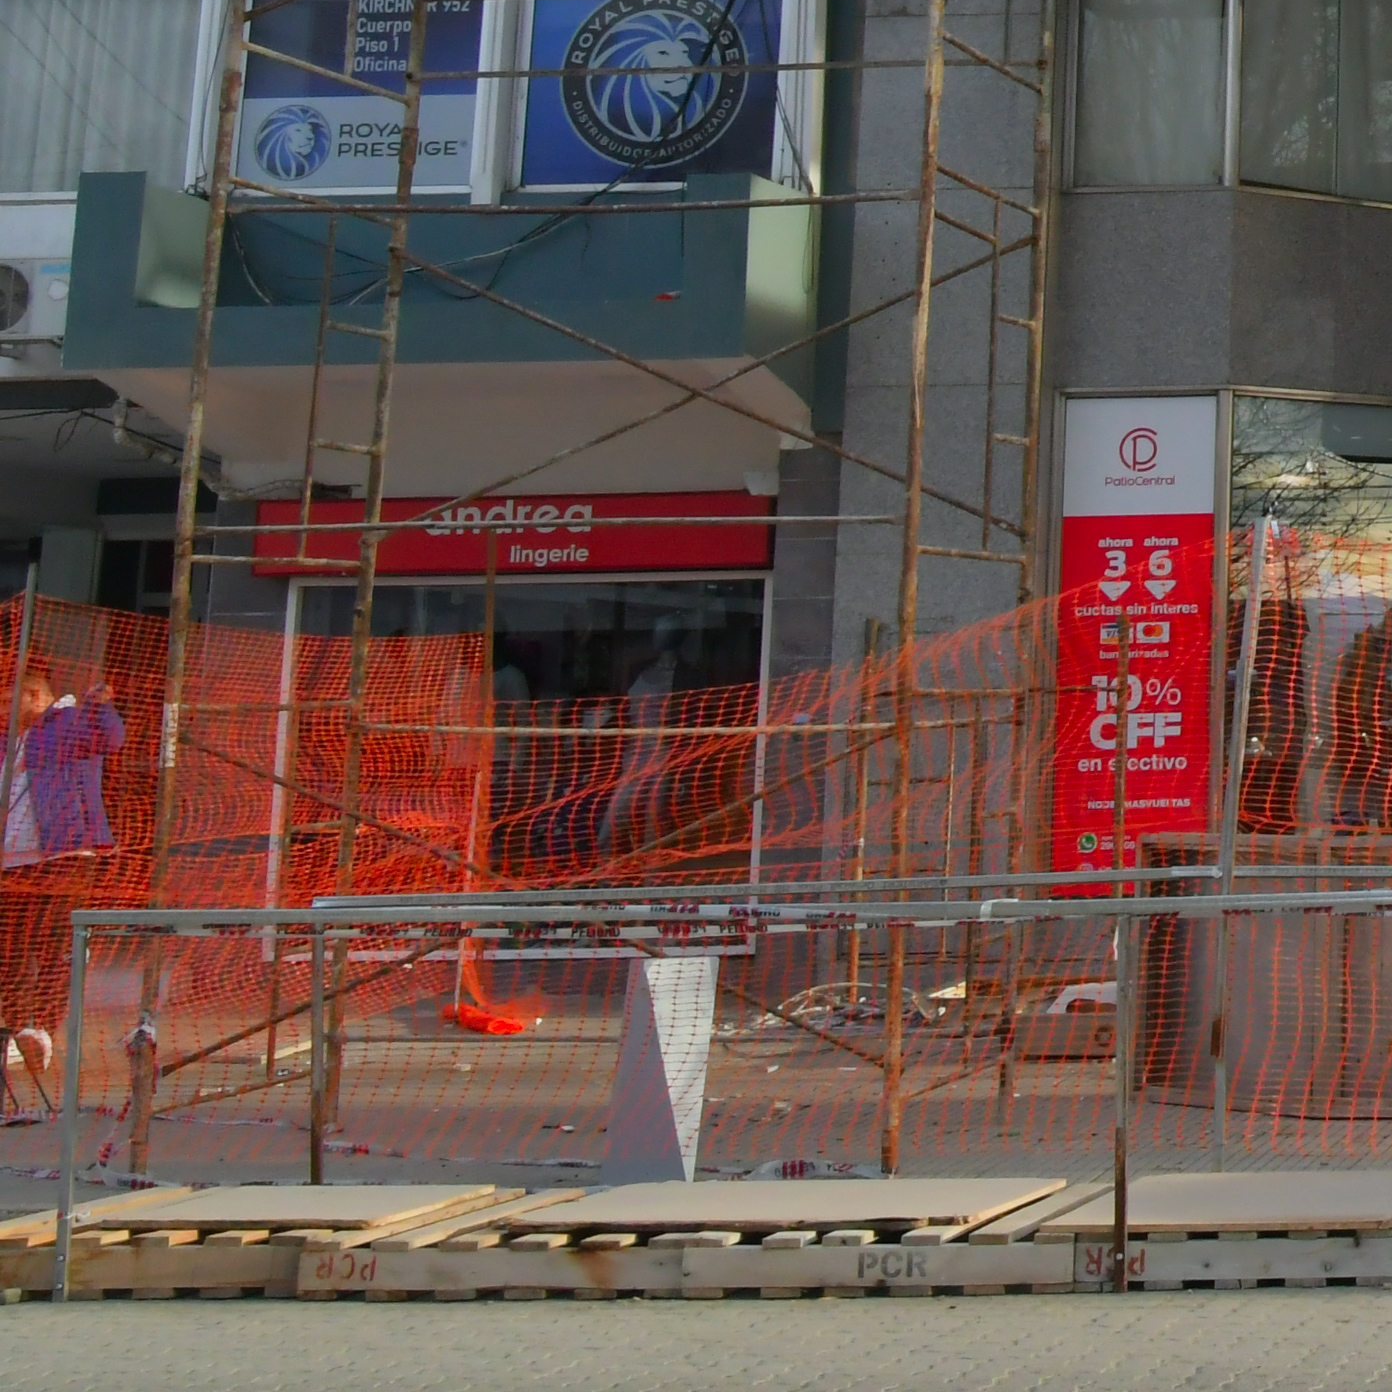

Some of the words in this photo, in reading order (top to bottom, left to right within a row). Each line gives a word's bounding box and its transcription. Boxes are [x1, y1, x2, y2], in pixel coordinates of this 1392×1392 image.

[356, 17, 412, 37] Cuerpo
[355, 36, 387, 52] Piso
[354, 56, 407, 72] Oficina
[339, 122, 403, 138] ROYA
[338, 140, 458, 157] PRESIGE
[1104, 475, 1176, 487] PatioCentral
[424, 499, 593, 536] andrea
[1098, 537, 1134, 548] ahora
[1143, 536, 1179, 547] ahora
[510, 545, 589, 567] lingerie
[1104, 550, 1127, 577] 3
[1148, 549, 1173, 577] 6
[1126, 603, 1147, 614] sin
[1150, 602, 1199, 614] interes
[1091, 674, 1182, 712] 10%
[1077, 759, 1102, 773] en
[1109, 755, 1188, 772] eectivo
[857, 1250, 929, 1278] PCR
